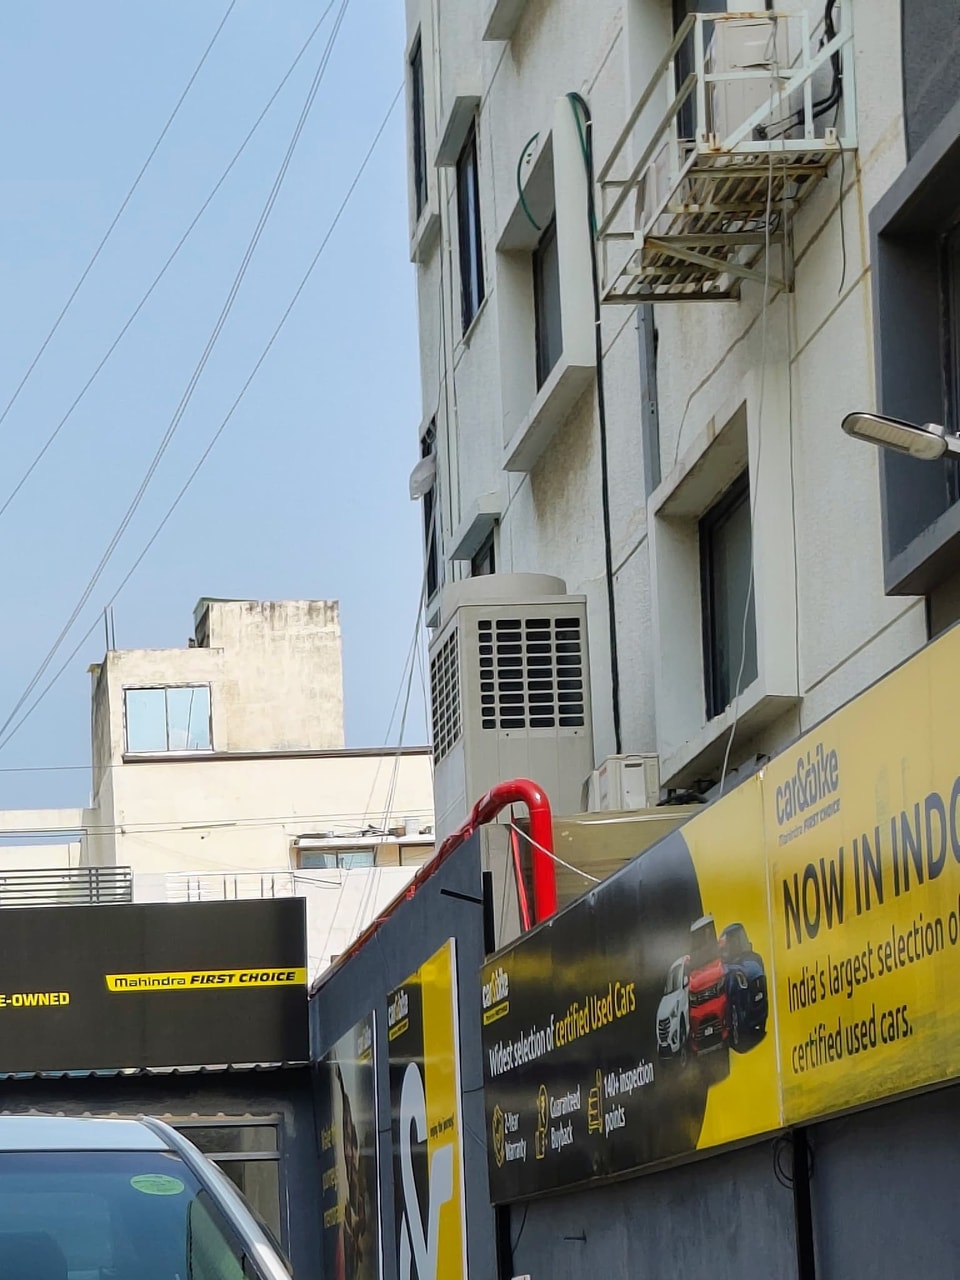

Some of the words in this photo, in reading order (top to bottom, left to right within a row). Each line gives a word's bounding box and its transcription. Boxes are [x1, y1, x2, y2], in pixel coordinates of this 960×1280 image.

[776, 743, 839, 826] car&bike
[783, 847, 844, 950] NOW
[853, 825, 884, 917] IN
[114, 977, 185, 988] Mahindra
[190, 974, 235, 985] FIRST
[239, 971, 296, 983] CHOICE
[788, 960, 826, 1013] India's
[828, 940, 874, 1000] largest
[877, 912, 945, 977] selection
[489, 1039, 514, 1078] Widest
[514, 1025, 546, 1066] selection
[546, 1014, 555, 1052] of
[555, 996, 590, 1047] certified
[590, 983, 613, 1030] Used
[614, 981, 636, 1018] Cars
[791, 1017, 843, 1075] certified
[846, 1003, 877, 1056] used
[880, 1004, 913, 1045] cars.
[619, 1059, 654, 1095] inspection
[605, 1104, 626, 1138] points
